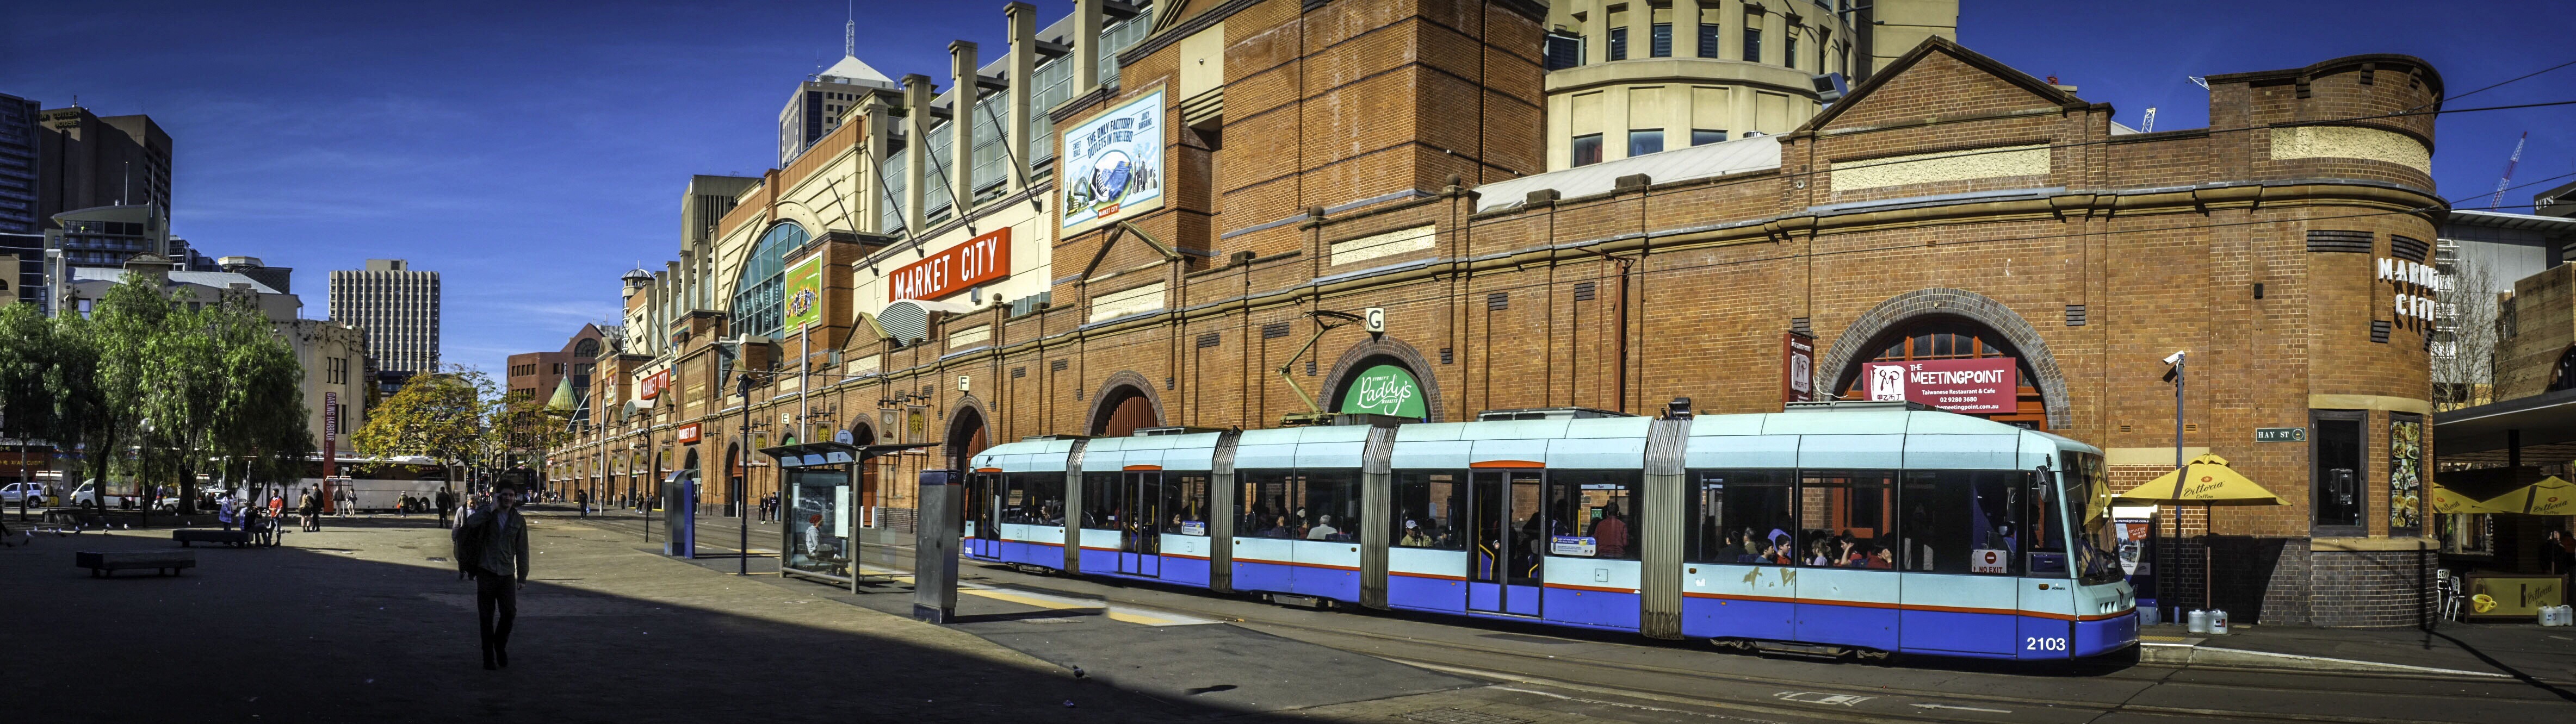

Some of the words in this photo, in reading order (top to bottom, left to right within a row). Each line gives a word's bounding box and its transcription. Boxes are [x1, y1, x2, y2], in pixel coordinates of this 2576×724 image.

[1138, 117, 1152, 130] BARGAINS
[1087, 131, 1096, 147] THE
[1097, 122, 1109, 139] ONLY
[1087, 136, 1106, 159] OUTLETS
[1107, 133, 1112, 146] IN
[2536, 196, 2554, 210] UTS
[1099, 208, 1111, 217] MARKET
[895, 254, 950, 301] MARKET
[961, 236, 998, 282] CITY
[2395, 294, 2435, 321] CITY
[1369, 310, 1382, 329] G
[642, 376, 657, 397] MARKET
[659, 371, 667, 388] CITY
[961, 377, 967, 389] F
[1910, 370, 2004, 384] MEETINGPOINT
[1357, 373, 1411, 416] Paddy's
[326, 393, 336, 416] DARLING
[783, 414, 788, 423] E
[326, 416, 335, 441] HARBOUR
[679, 428, 689, 440] MARKET
[2183, 482, 2225, 497] Vittoria
[2533, 500, 2569, 512] Vittoria
[2528, 584, 2553, 604] Vittoria
[2027, 637, 2066, 651] 2103
